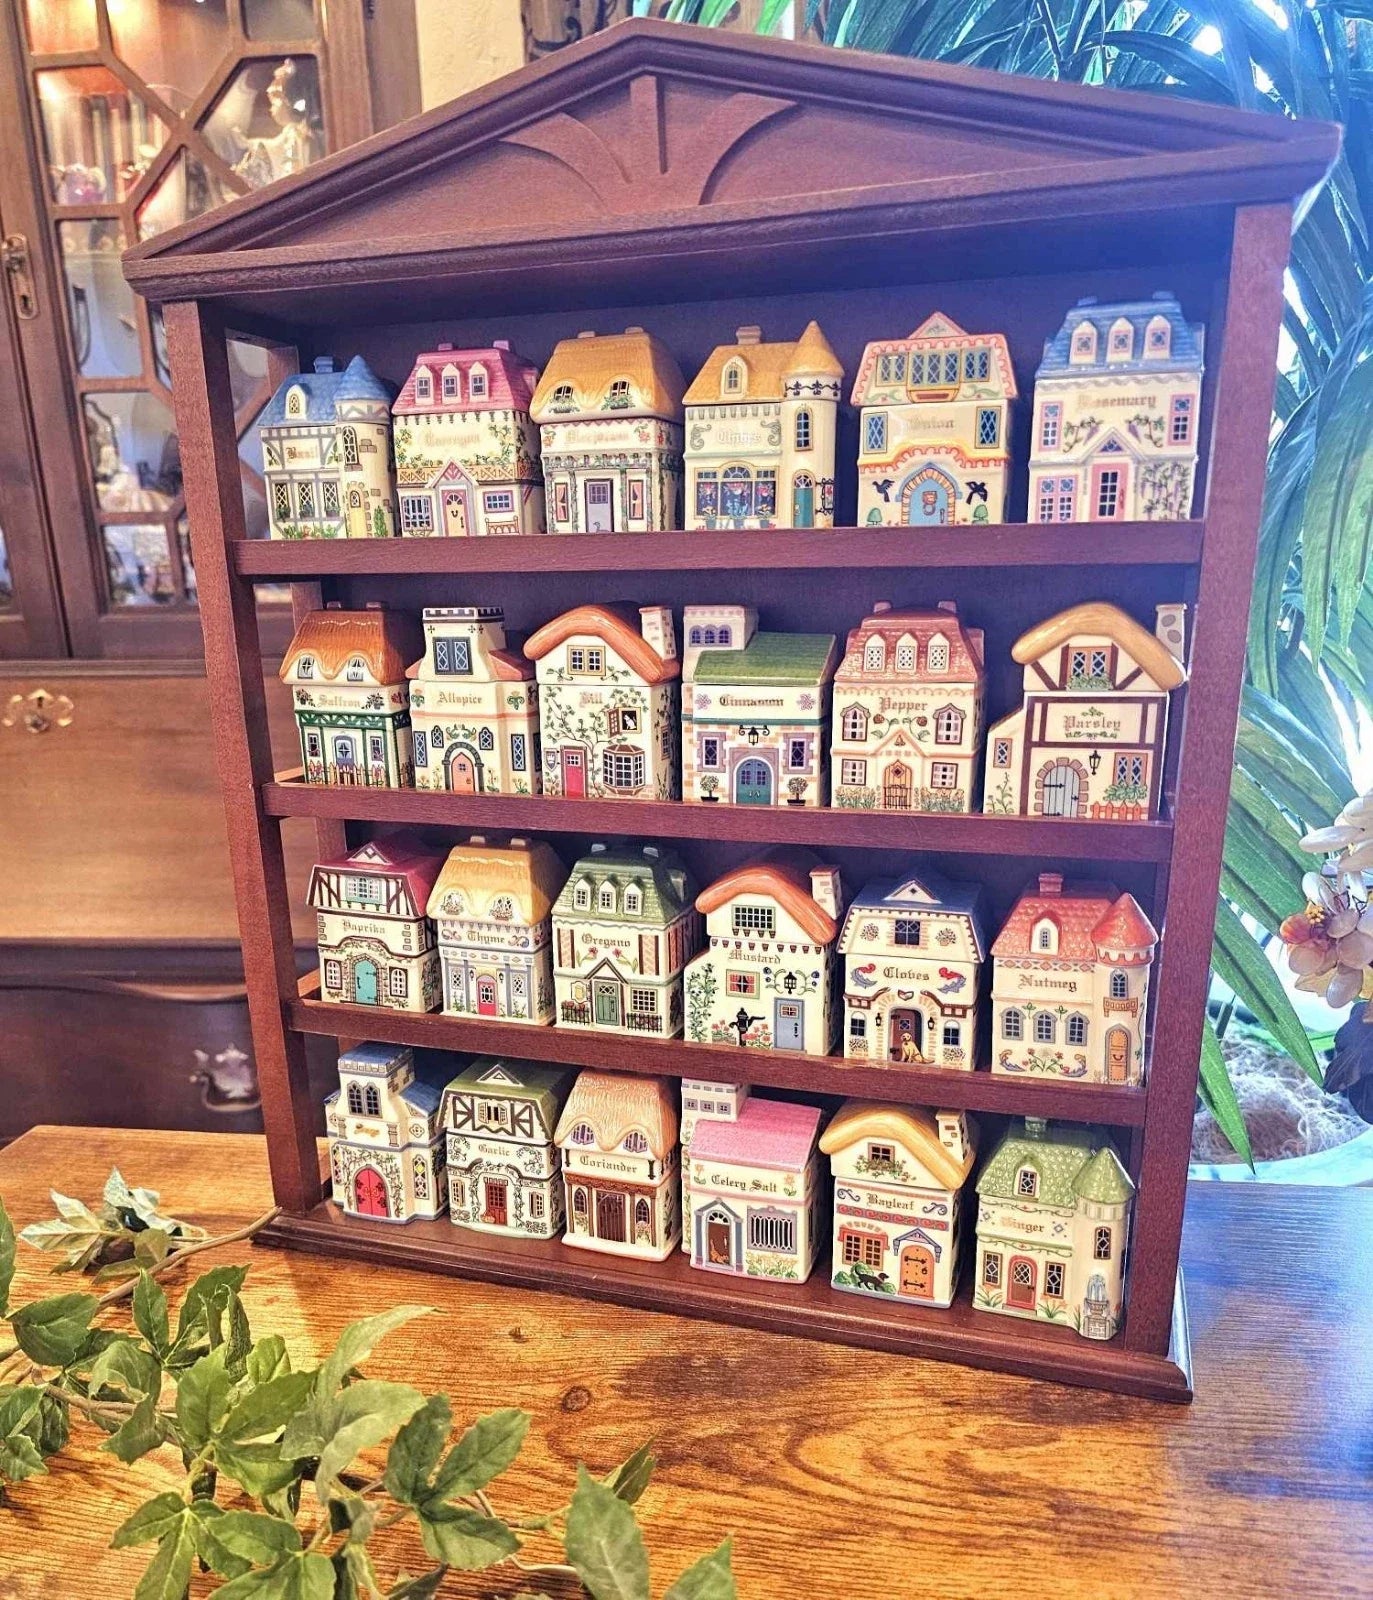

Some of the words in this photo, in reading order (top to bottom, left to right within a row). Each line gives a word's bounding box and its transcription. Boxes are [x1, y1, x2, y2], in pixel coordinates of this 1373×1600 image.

[437, 691, 483, 706] Allspice
[719, 694, 784, 707] Cinnamon
[878, 696, 928, 714] Pepper
[1063, 715, 1121, 732] Parsley
[343, 919, 386, 934] Paprika
[466, 930, 505, 944] Thyme
[581, 932, 631, 949] Oregano
[728, 949, 782, 964] Mustard
[883, 966, 930, 981] Cloves
[1018, 974, 1078, 993] Nutmeg
[478, 1143, 510, 1157] Garlic
[579, 1155, 638, 1174] Coriander
[711, 1173, 746, 1191] Celery
[749, 1179, 777, 1193] Salt
[865, 1193, 915, 1211] Bayleaf
